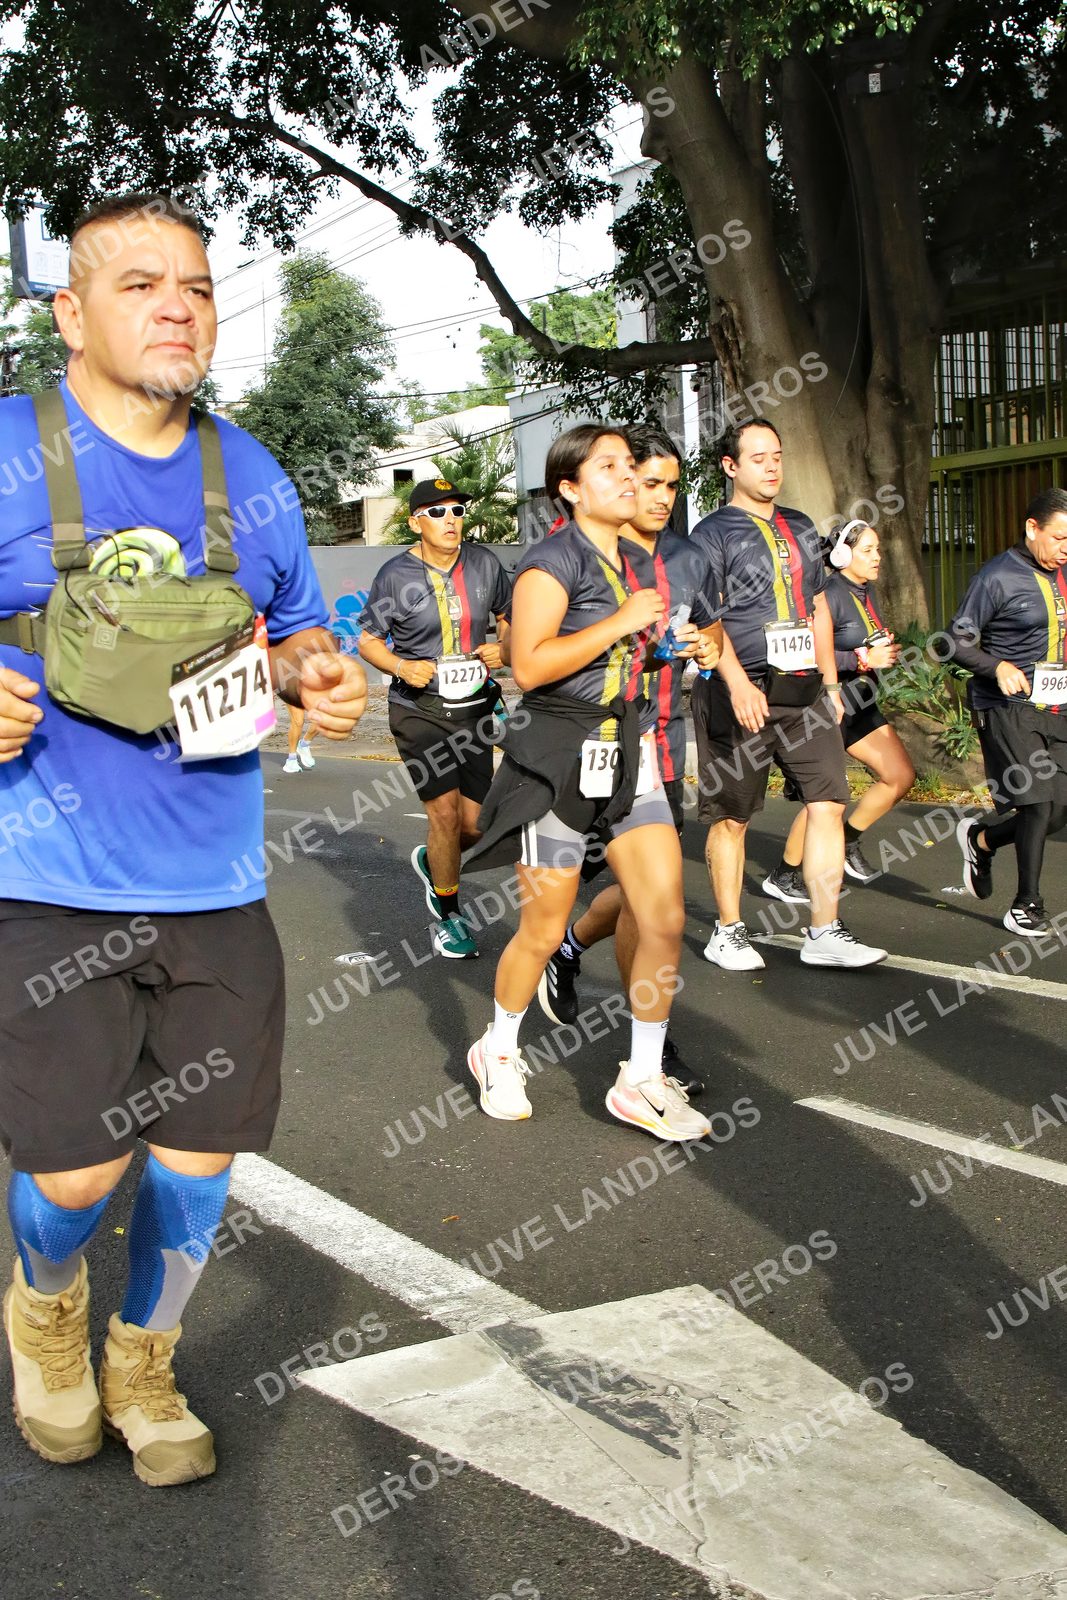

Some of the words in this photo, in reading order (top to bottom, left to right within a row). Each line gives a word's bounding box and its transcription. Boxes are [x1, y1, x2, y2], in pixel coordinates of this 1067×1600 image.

[772, 635, 812, 654] 11476
[443, 665, 483, 685] 12271
[180, 659, 267, 733] 11274
